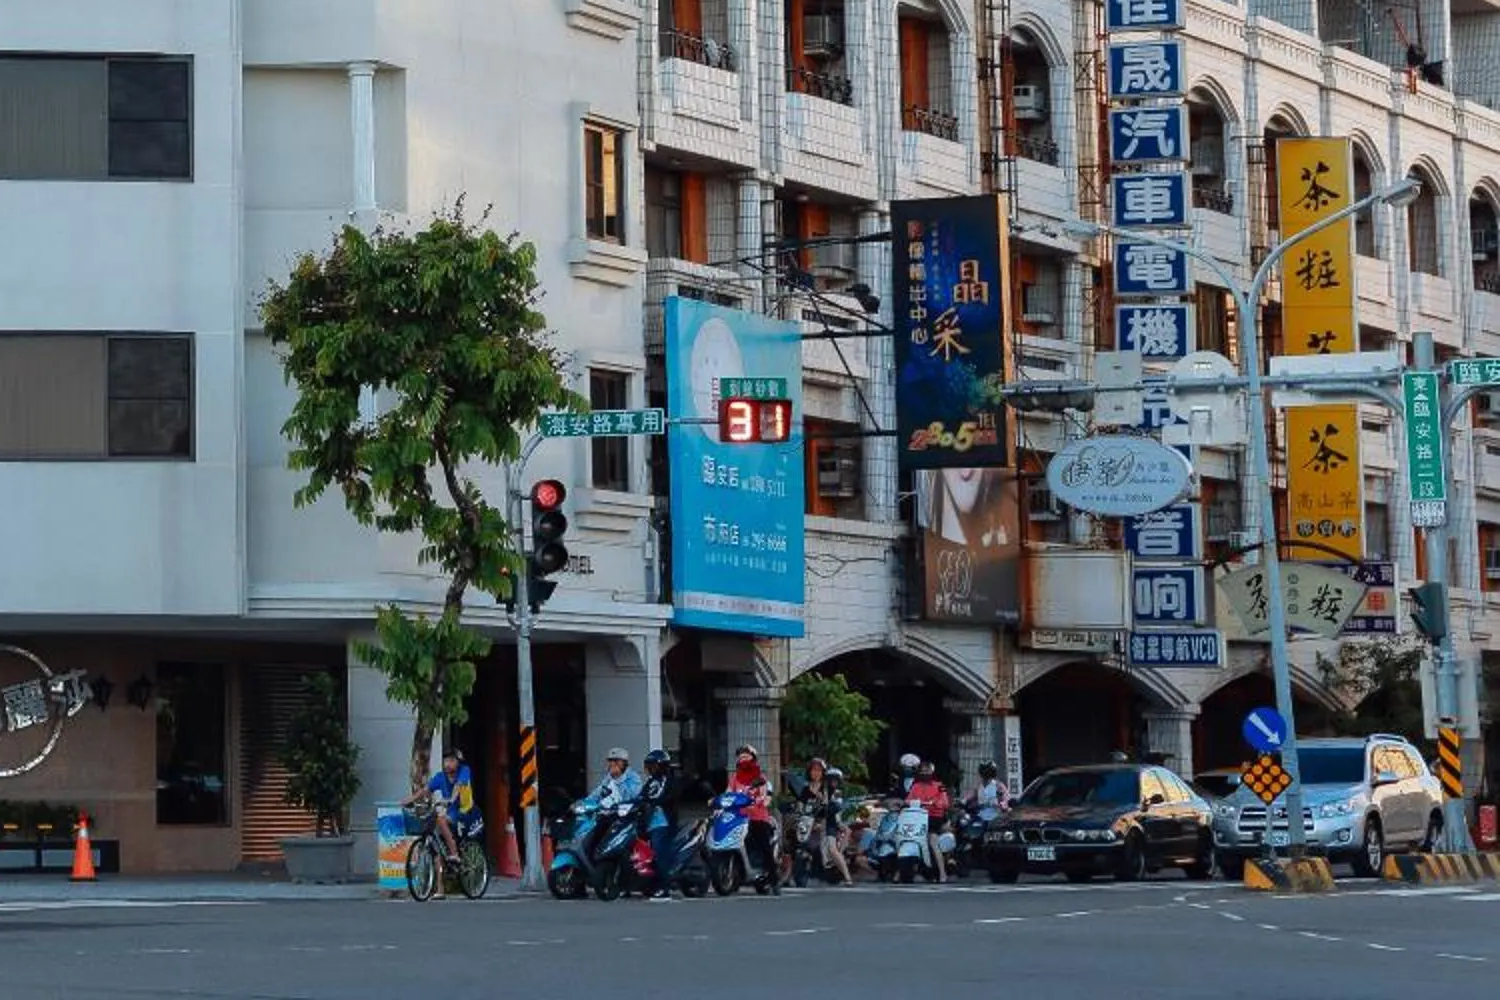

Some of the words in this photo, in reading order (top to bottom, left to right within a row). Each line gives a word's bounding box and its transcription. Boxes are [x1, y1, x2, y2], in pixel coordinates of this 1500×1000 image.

[547, 411, 660, 435] 海安路專用
[729, 401, 784, 441] 31
[1131, 635, 1216, 661] 衛星導航VCD
